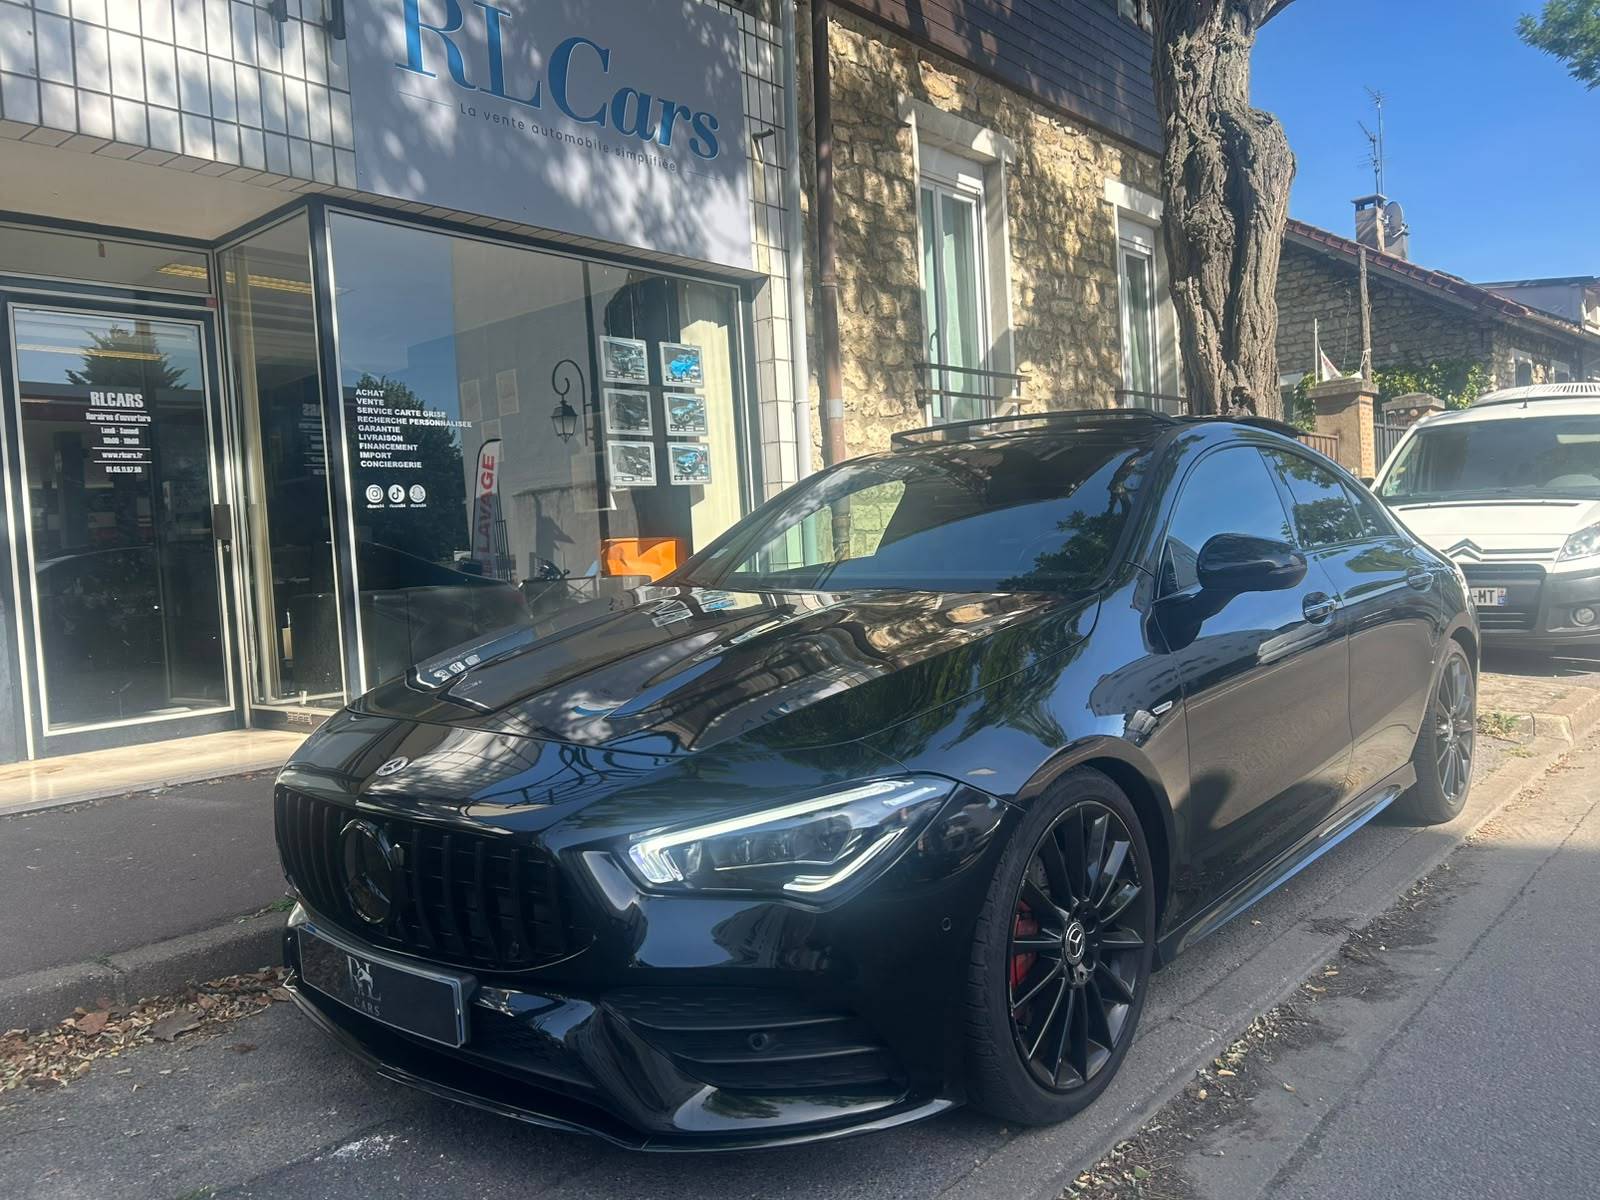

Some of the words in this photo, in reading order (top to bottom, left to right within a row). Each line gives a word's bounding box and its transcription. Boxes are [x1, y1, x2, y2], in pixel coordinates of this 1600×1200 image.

[460, 102, 477, 117] La
[483, 110, 526, 131] vente
[531, 123, 610, 154] automobile
[614, 146, 678, 173] simplifiée
[356, 389, 384, 397] ACHAT
[90, 391, 144, 408] RLCARS
[356, 397, 384, 406] VENTE
[85, 412, 114, 421] Horaires
[357, 406, 393, 415] SERVICE
[394, 409, 421, 417] CARTE
[423, 410, 446, 418] GRISE
[357, 415, 407, 425] RECHERCHE
[358, 424, 401, 433] GARANTIE
[358, 433, 403, 442] LIVRAISON
[359, 443, 418, 451] FINANCEMENT
[360, 451, 392, 459] IMPORT
[360, 460, 422, 468] CONCIERGERIE
[478, 453, 496, 553] LAVAGE
[353, 996, 381, 1017] CARS
